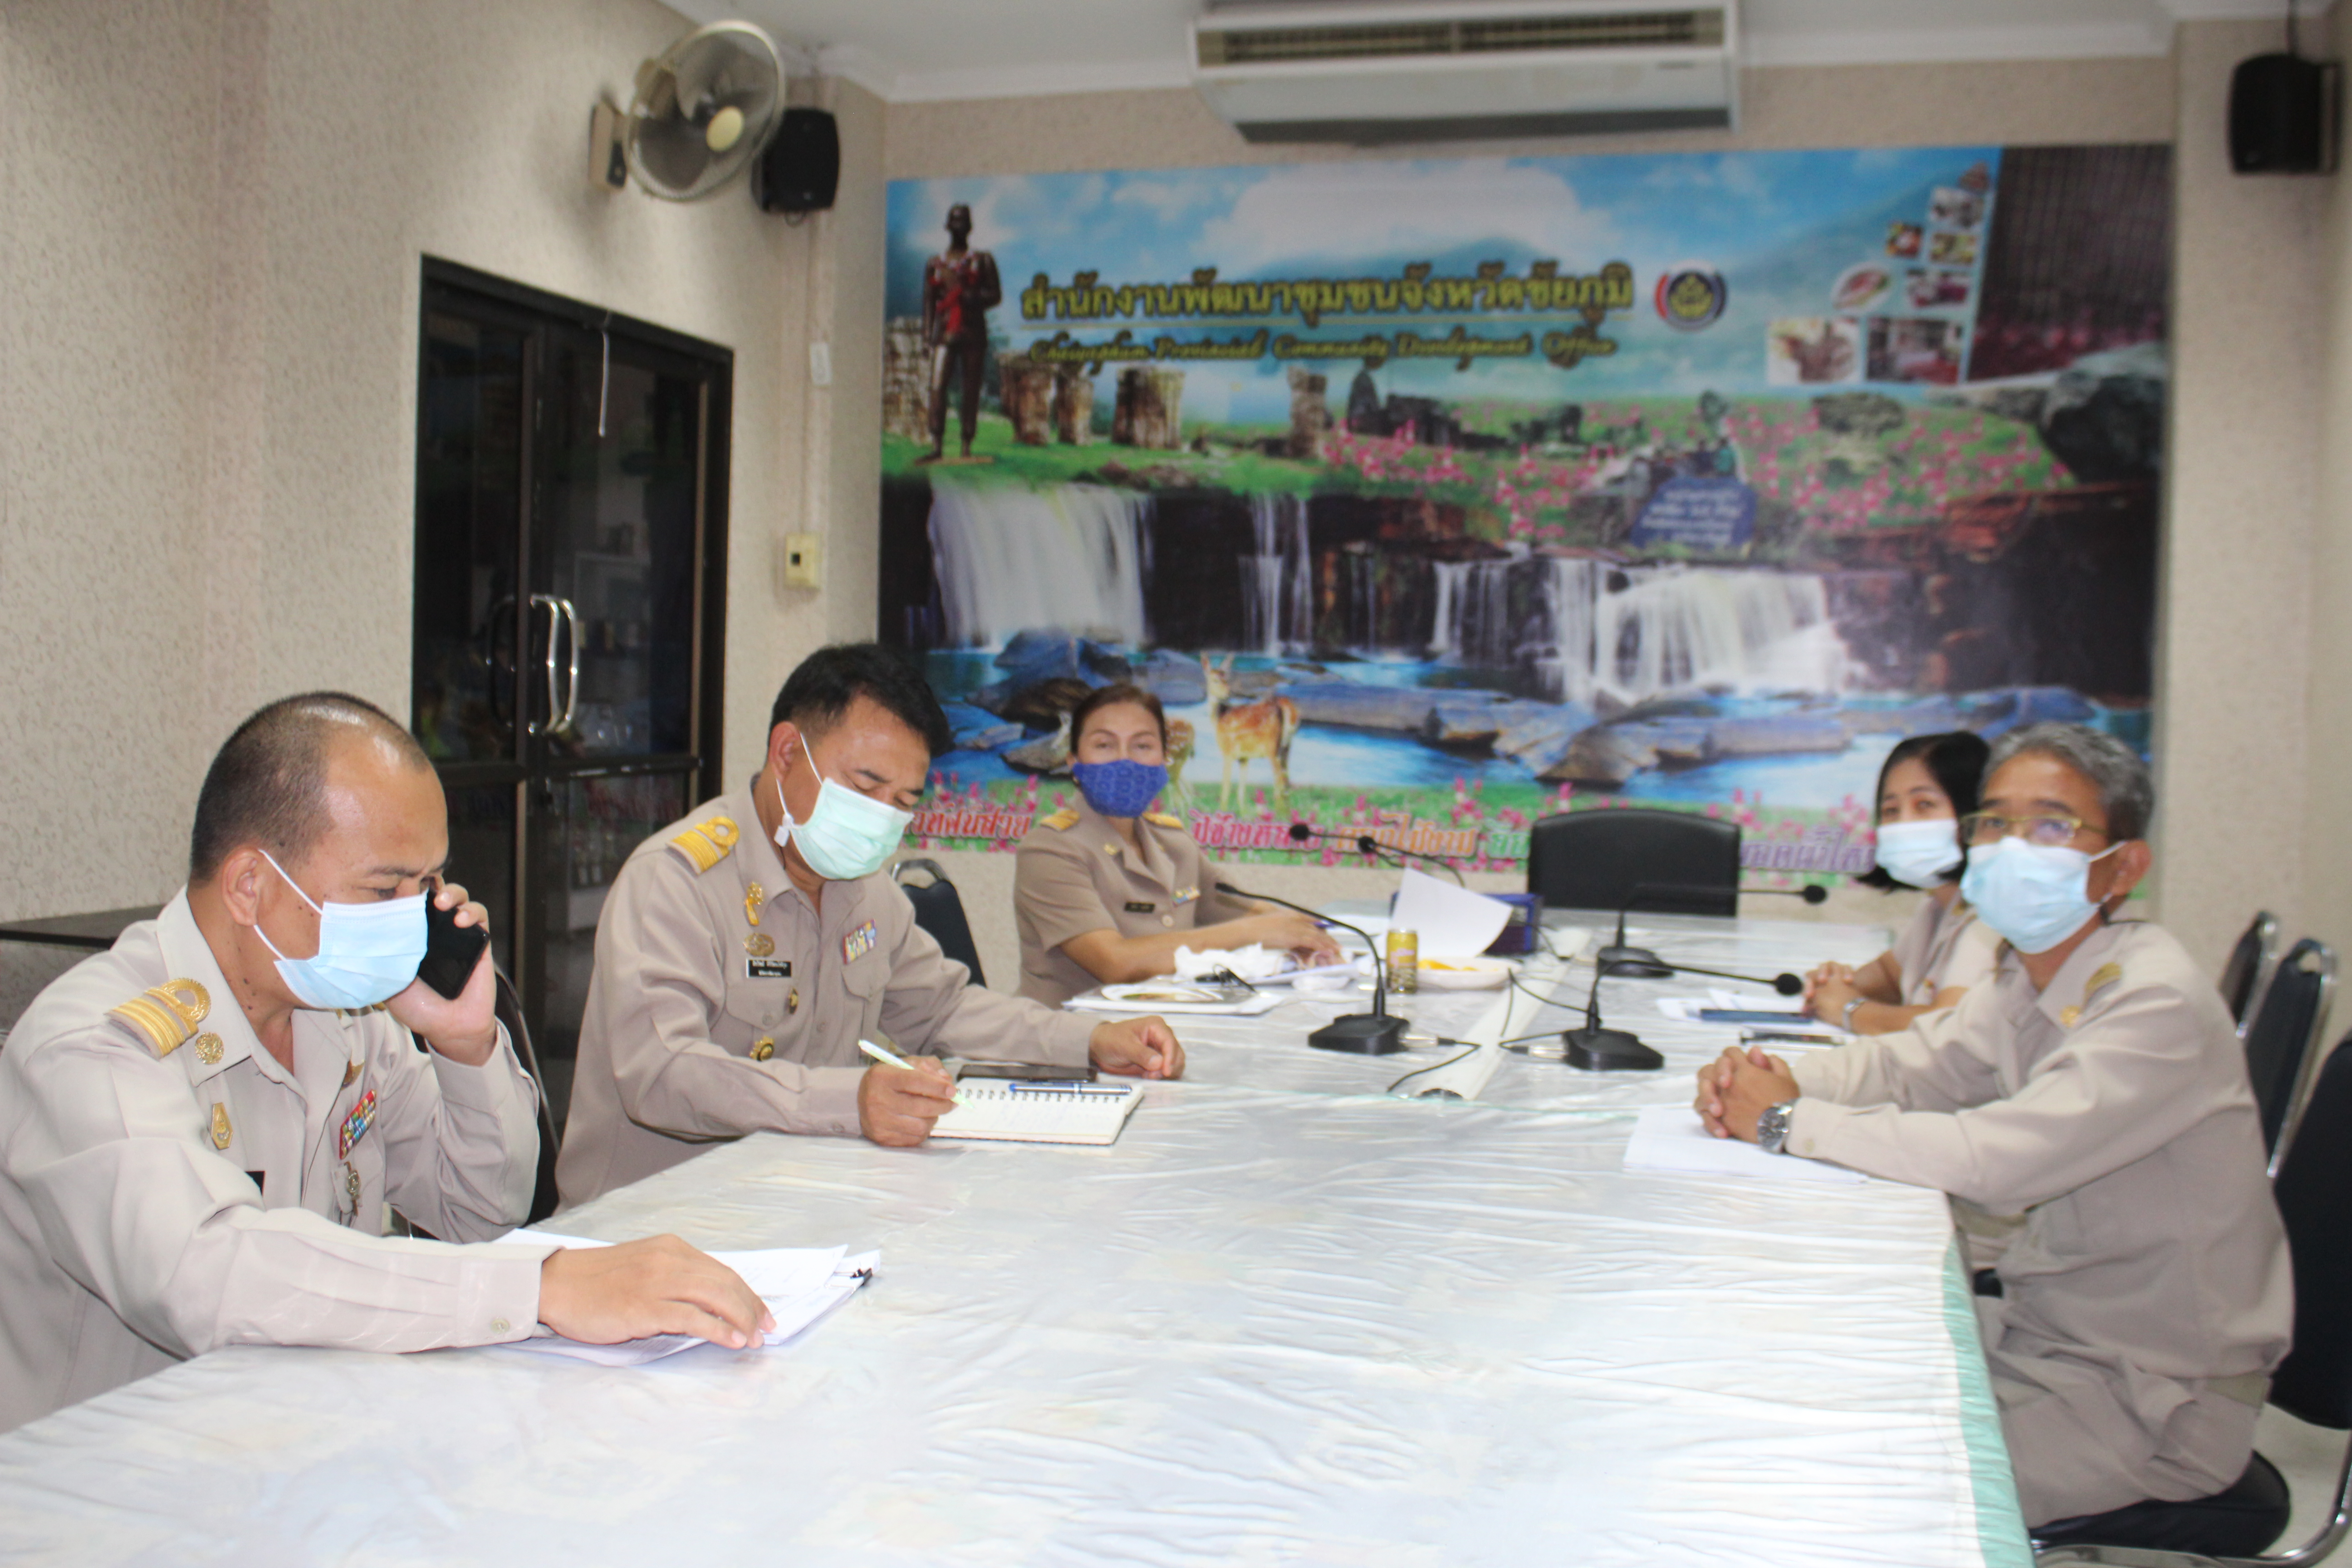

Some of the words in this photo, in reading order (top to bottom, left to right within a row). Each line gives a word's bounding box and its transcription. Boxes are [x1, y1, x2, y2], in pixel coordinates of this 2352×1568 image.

[1021, 262, 1633, 328] สำนักงานพัฒนาชุมชนจังหวัดชัยภูมิ
